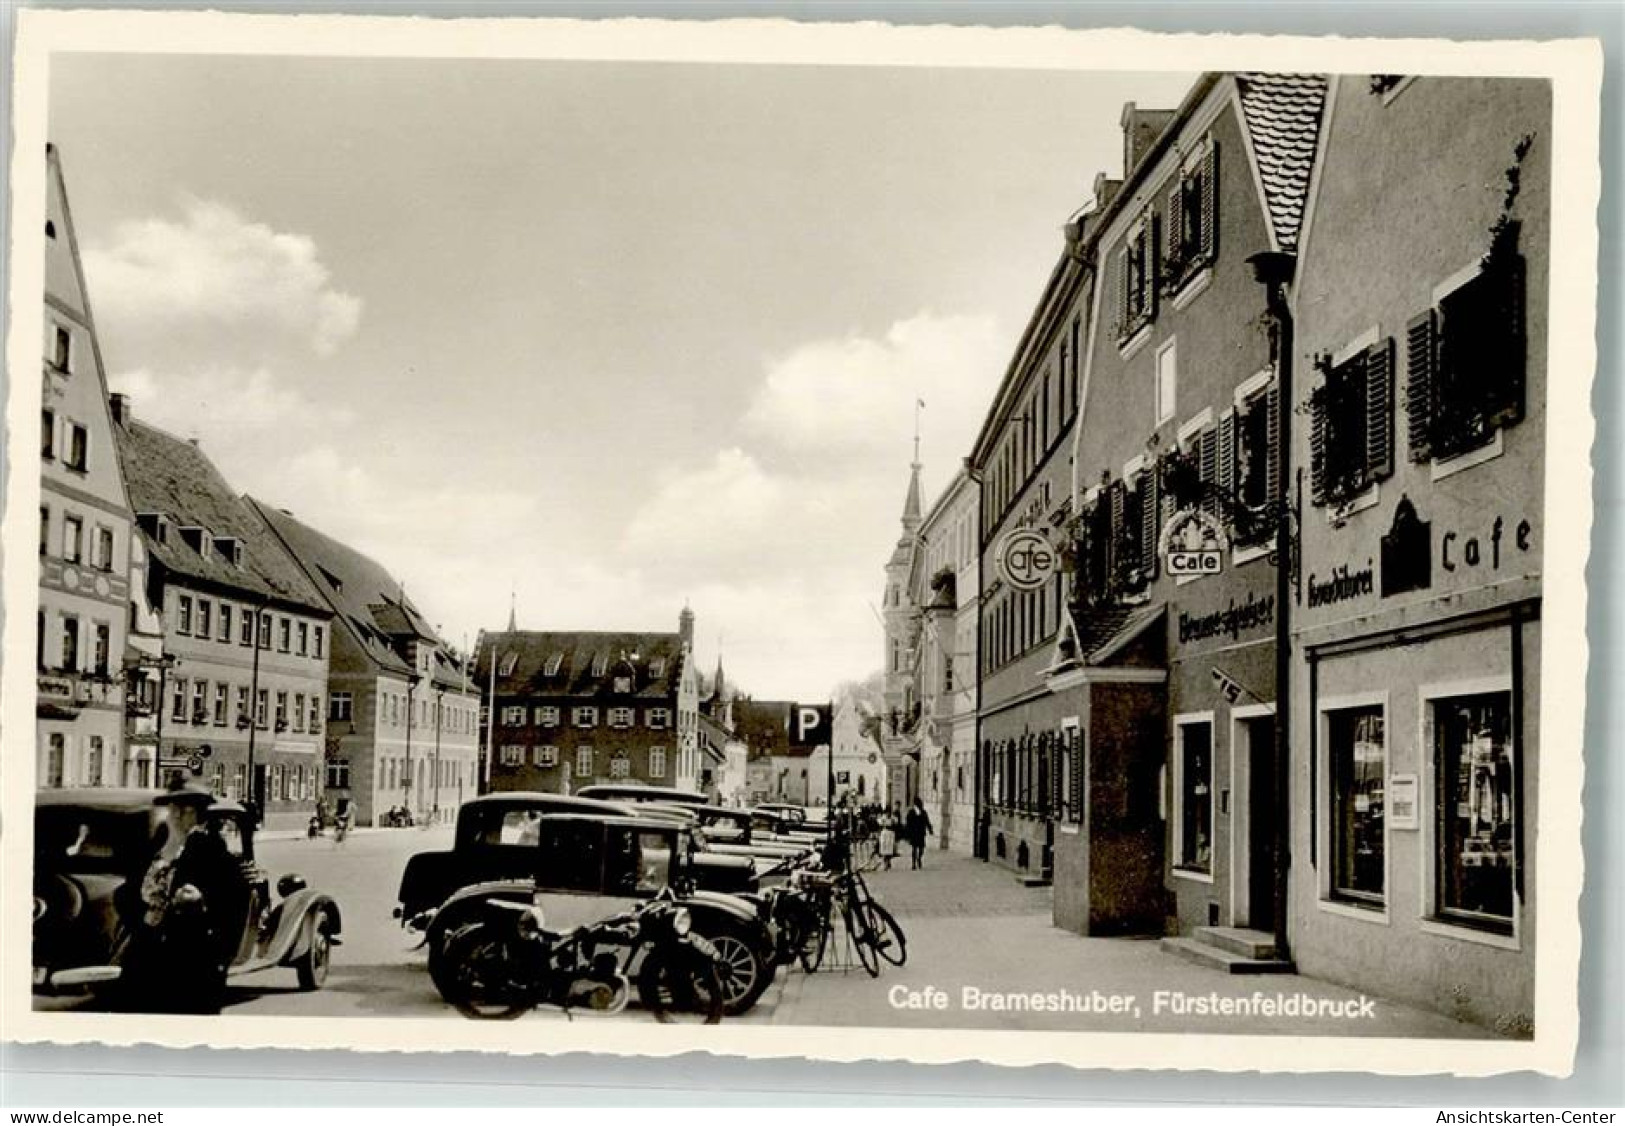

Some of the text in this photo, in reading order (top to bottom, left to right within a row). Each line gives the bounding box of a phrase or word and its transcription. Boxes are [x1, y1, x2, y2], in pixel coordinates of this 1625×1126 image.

[1004, 536, 1052, 585] Cafe
[1172, 553, 1217, 570] Cafe
[1442, 515, 1530, 573] Cafe
[798, 707, 820, 742] P
